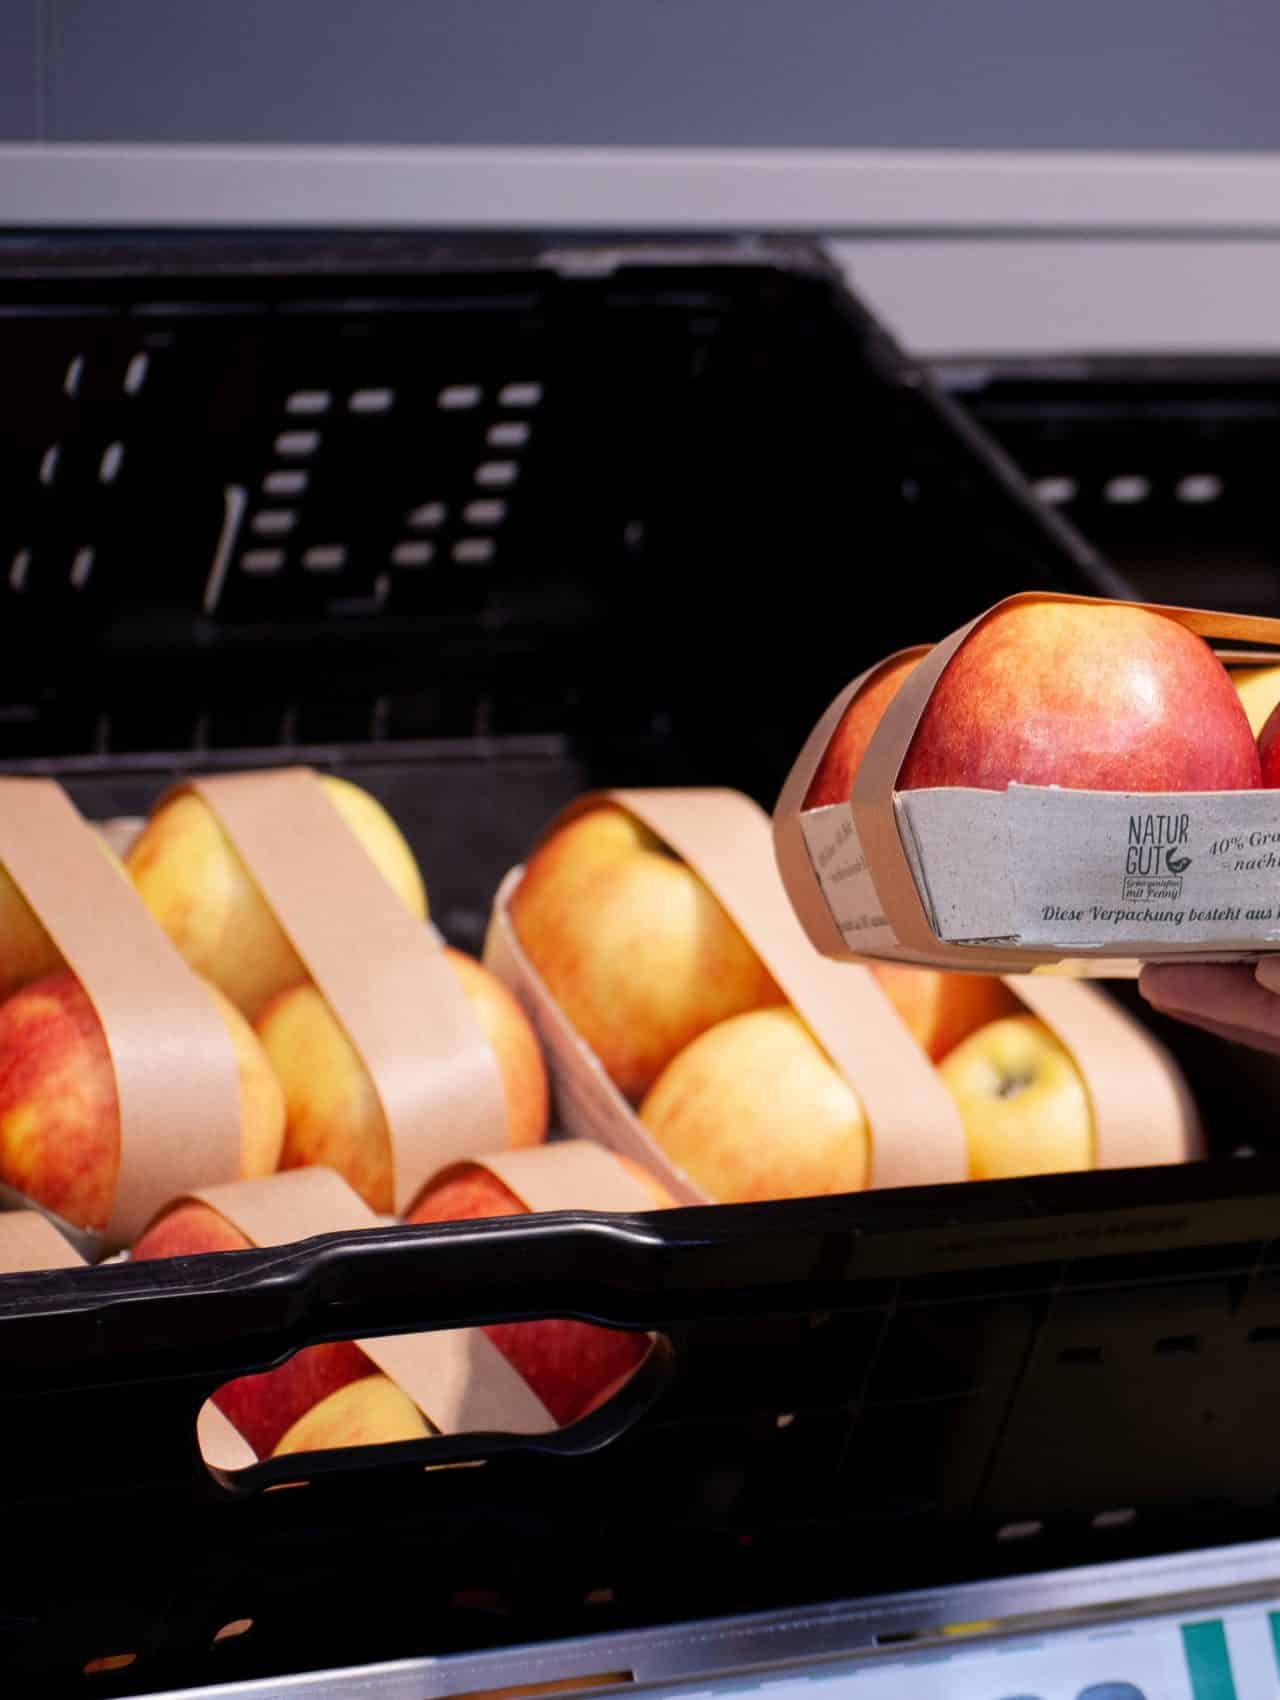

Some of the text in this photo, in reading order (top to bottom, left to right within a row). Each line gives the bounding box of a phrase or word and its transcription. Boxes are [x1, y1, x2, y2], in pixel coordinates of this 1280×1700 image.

[1128, 814, 1189, 845] NATUR
[1209, 836, 1244, 856] 40%
[1126, 845, 1165, 875] GUT
[1126, 887, 1179, 900] mit Penny
[1041, 905, 1084, 922] Diese
[1088, 906, 1185, 925] Verpackung
[1188, 906, 1241, 922] besteht
[1245, 907, 1273, 920] aus
